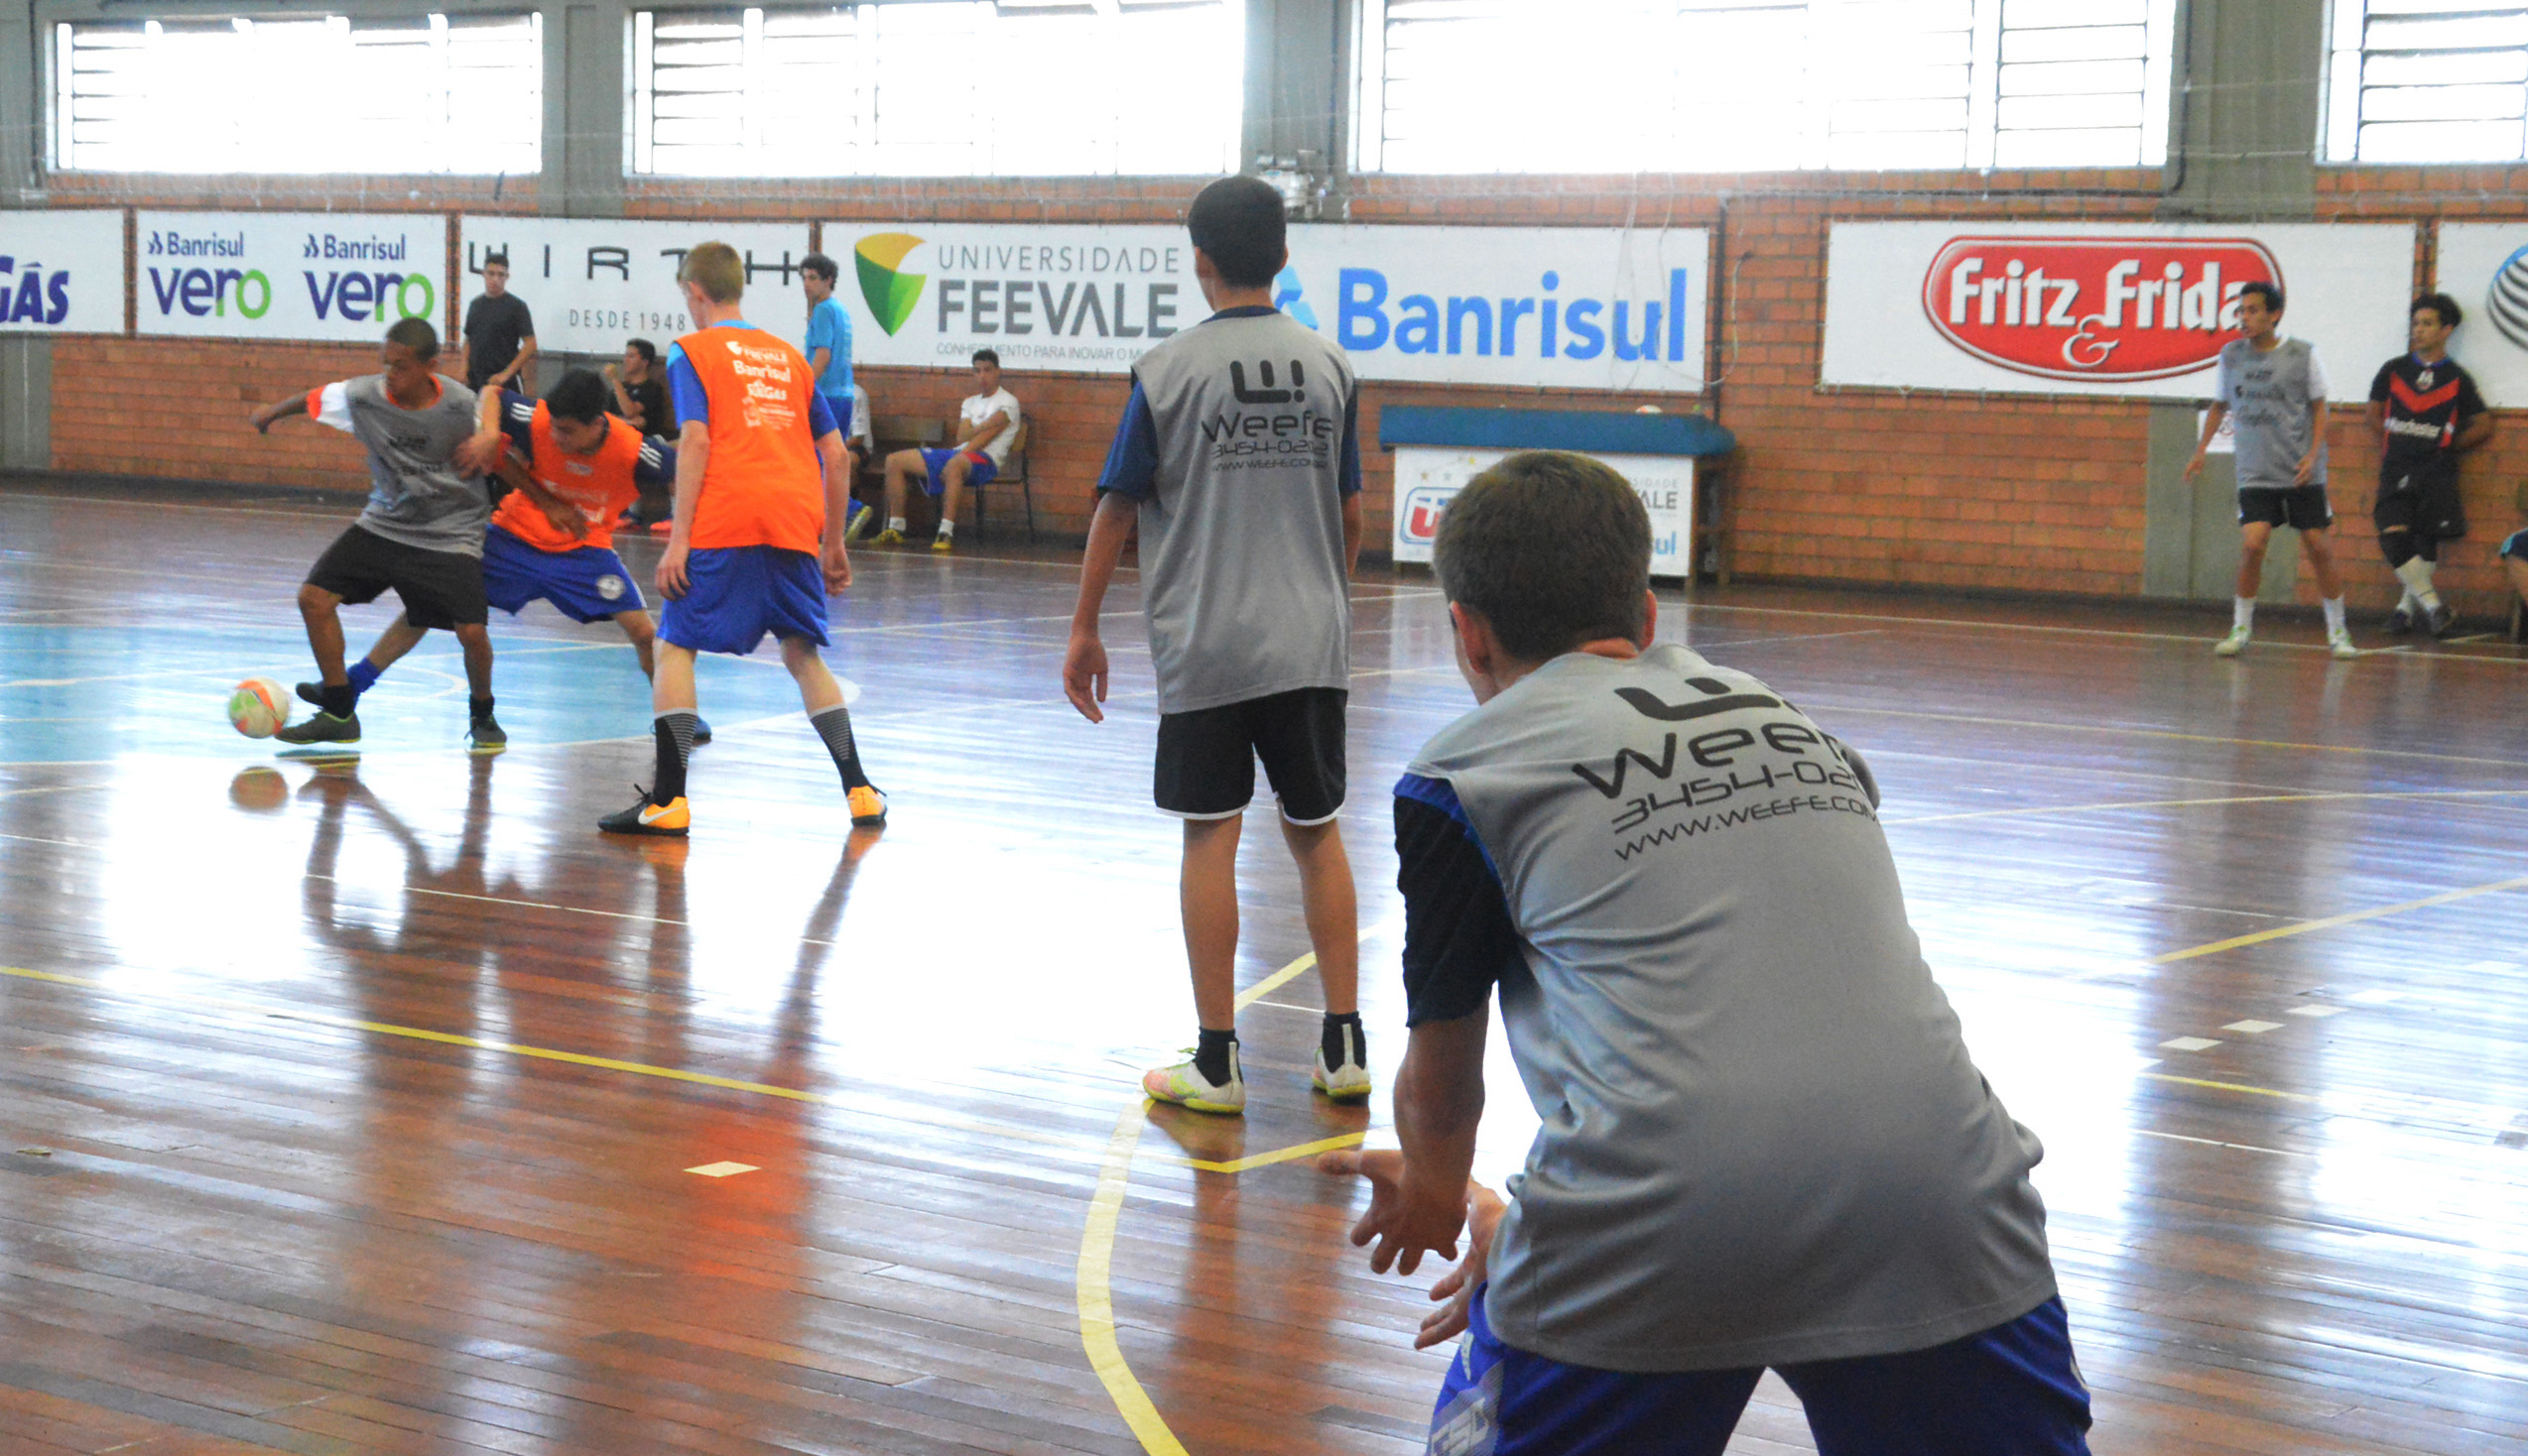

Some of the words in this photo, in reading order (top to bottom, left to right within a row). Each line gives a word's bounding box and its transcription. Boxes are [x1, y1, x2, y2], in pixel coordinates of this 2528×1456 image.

[167, 231, 245, 258] Banrisul
[323, 233, 407, 261] Banrisul
[939, 245, 1180, 273] UNIVERSIDADE
[148, 267, 272, 320] vero
[303, 270, 435, 322] vero
[939, 279, 1180, 338] FEEVALE
[1949, 257, 2080, 327] Fritz
[2104, 259, 2244, 331] Frida
[569, 308, 630, 329] DESDE
[640, 311, 686, 331] 1948
[1337, 267, 1688, 362] Banrisul
[1034, 344, 1068, 358] PARA
[1069, 346, 1114, 359] INOVAR
[1116, 347, 1127, 361] O
[2062, 312, 2120, 369] &
[732, 359, 792, 383] Banrisul
